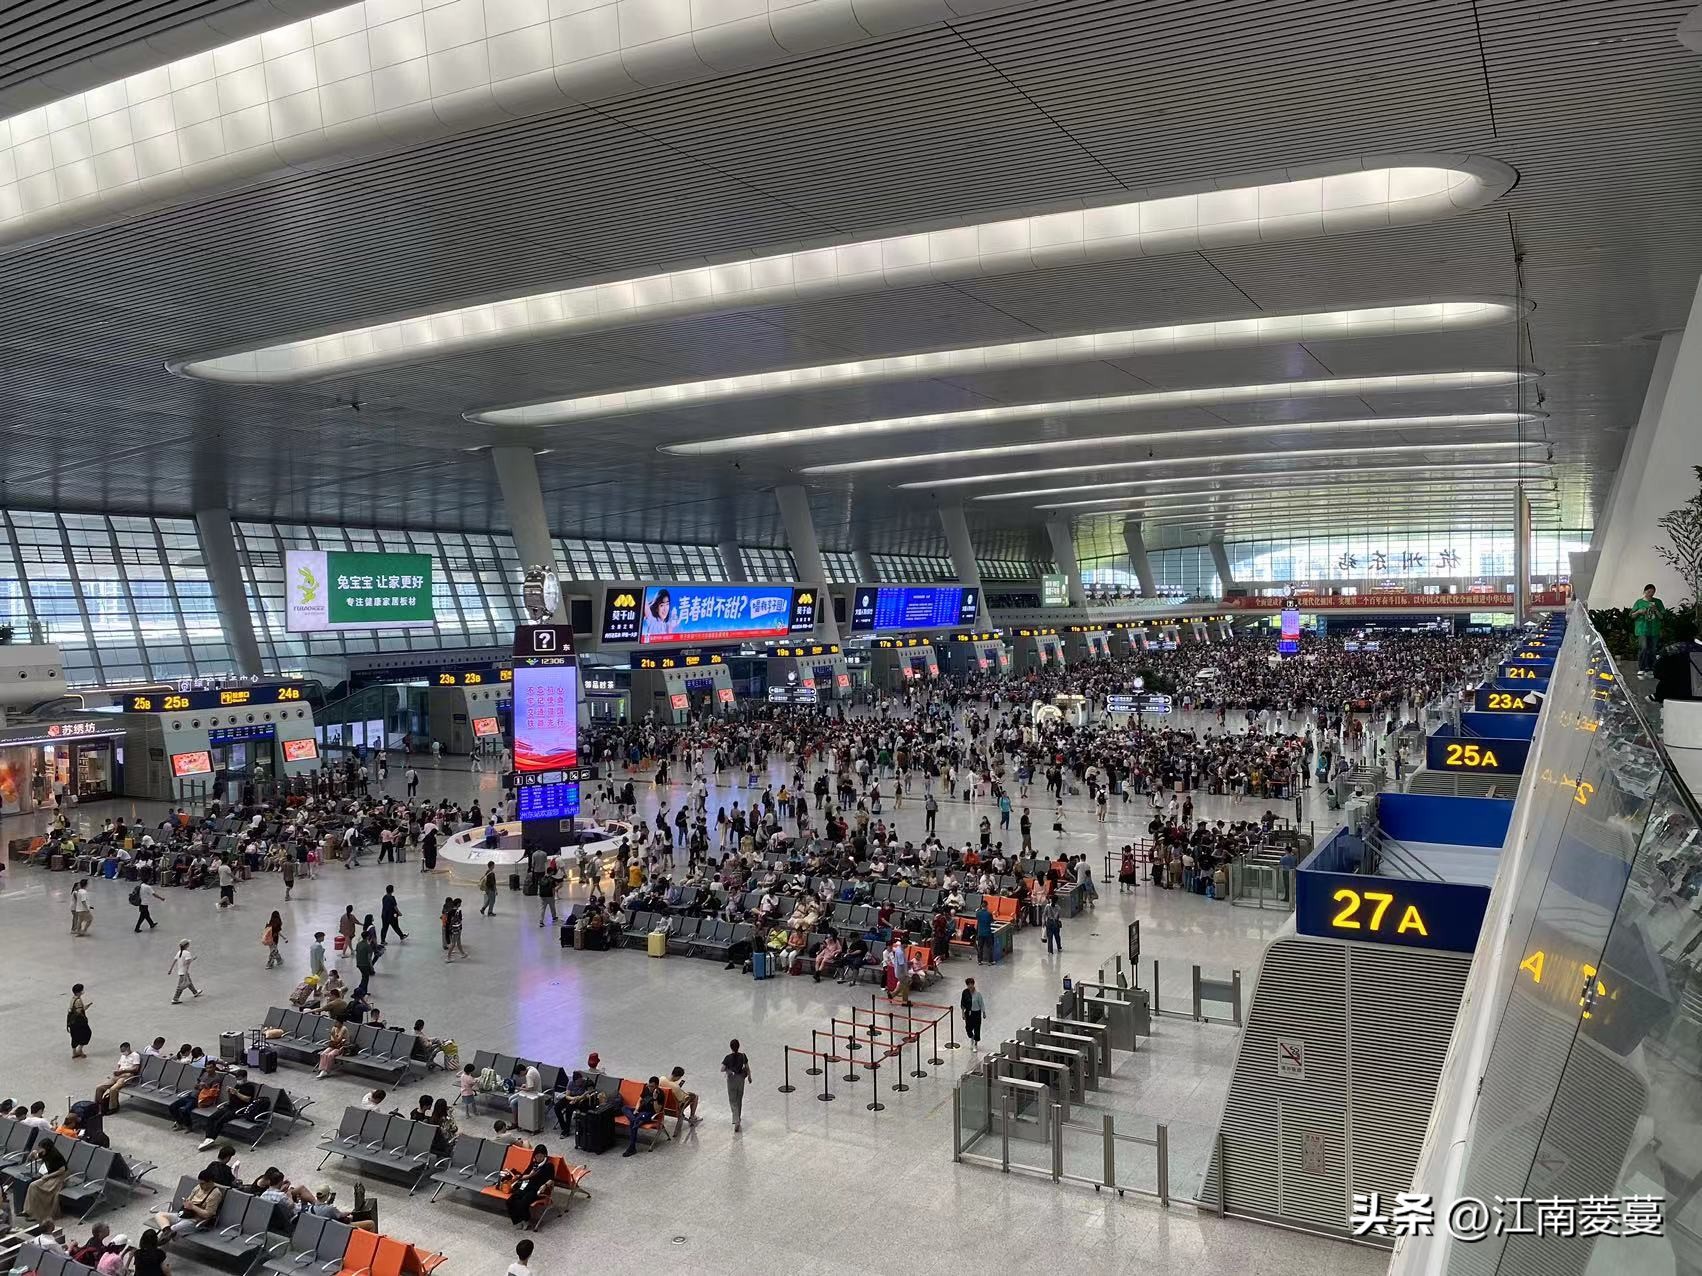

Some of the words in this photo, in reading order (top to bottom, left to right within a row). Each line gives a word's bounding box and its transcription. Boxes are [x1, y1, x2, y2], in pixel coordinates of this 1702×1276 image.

[337, 575, 373, 589] 兔宝宝
[376, 575, 423, 589] 让家更好
[346, 597, 416, 606] 专注健康家居板材
[612, 610, 635, 620] 莫干山
[641, 658, 656, 668] 21B
[439, 674, 455, 684] 23B
[465, 673, 481, 683] 23B
[1509, 667, 1536, 678] 21A
[278, 687, 300, 700] 24B
[133, 697, 151, 710] 25B
[164, 696, 190, 709] 25B
[1488, 693, 1524, 709] 23A
[61, 722, 96, 735] 苏绣坊
[1446, 744, 1498, 767] 25A
[1332, 889, 1428, 936] 27A
